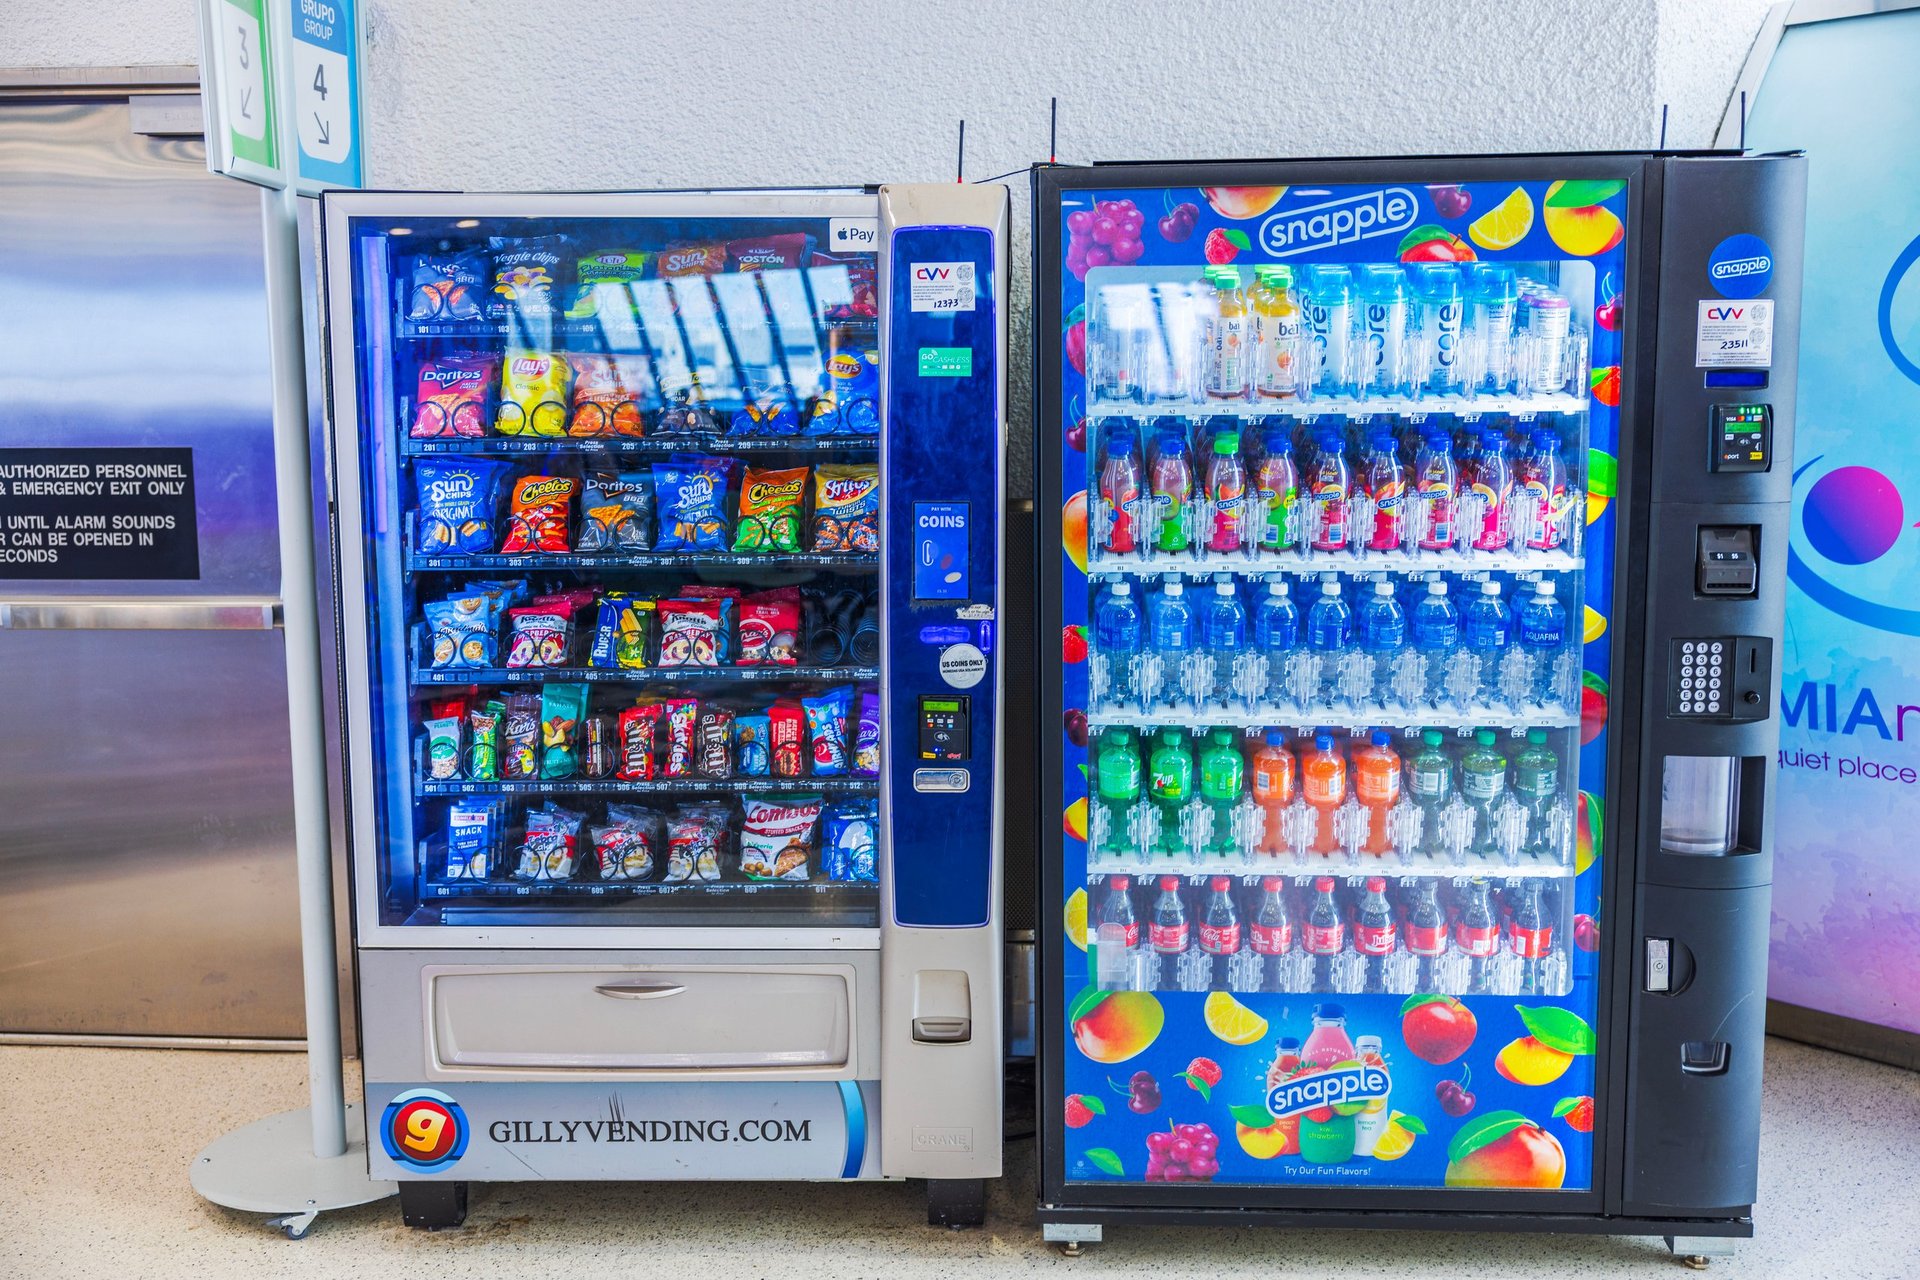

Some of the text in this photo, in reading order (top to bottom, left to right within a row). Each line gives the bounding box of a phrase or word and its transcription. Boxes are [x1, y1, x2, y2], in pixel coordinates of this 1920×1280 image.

[301, 0, 335, 24] GRUPO
[304, 18, 333, 40] GROUP
[238, 26, 249, 70] 3
[313, 63, 328, 101] 4
[1270, 190, 1407, 248] snapple
[850, 228, 874, 243] Pay
[493, 250, 560, 265] Veggie Chips
[1716, 256, 1767, 276] snapple
[917, 267, 950, 280] CVV
[934, 299, 959, 308] 12373
[1707, 307, 1744, 321] CVV
[418, 325, 429, 333] 101
[497, 325, 510, 333] 103
[1438, 304, 1456, 367] core
[1720, 339, 1748, 350] 23511
[513, 358, 549, 376] Lay's
[424, 370, 481, 381] Doritos
[515, 382, 540, 391] Classic
[424, 443, 435, 452] 201
[523, 443, 536, 451] 203
[663, 442, 674, 450] 207
[738, 442, 750, 450] 209
[96, 464, 187, 478] PERSONNEL
[13, 481, 185, 495] EMERGENCY EXIT ONLY
[431, 479, 473, 502] Sun
[521, 478, 572, 502] Cheetos
[586, 479, 643, 492] Doritos
[749, 480, 801, 502] Cheetos
[445, 491, 472, 499] CHIPS
[8, 515, 175, 529] UNTIL ALARM SOUNDS
[919, 515, 965, 528] COINS
[12, 533, 153, 546] CAN BE OPENED IN
[1525, 632, 1560, 641] AQUAFINA
[969, 659, 983, 667] ONLY
[433, 673, 444, 681] 401
[1838, 755, 1917, 784] place
[580, 783, 592, 791] 505
[1153, 772, 1173, 790] 7up
[425, 784, 436, 792] 501
[462, 784, 474, 792] 502
[455, 825, 482, 837] SNACK
[438, 887, 449, 895] 601
[1321, 1047, 1348, 1058] NATURAL
[1274, 1067, 1383, 1111] snapple
[488, 1119, 812, 1144] GILLYVENDING.COM
[1308, 1132, 1344, 1140] strawberry
[917, 1134, 967, 1145] CRANE
[1284, 1166, 1371, 1176] Try Our Fun Flavors!
